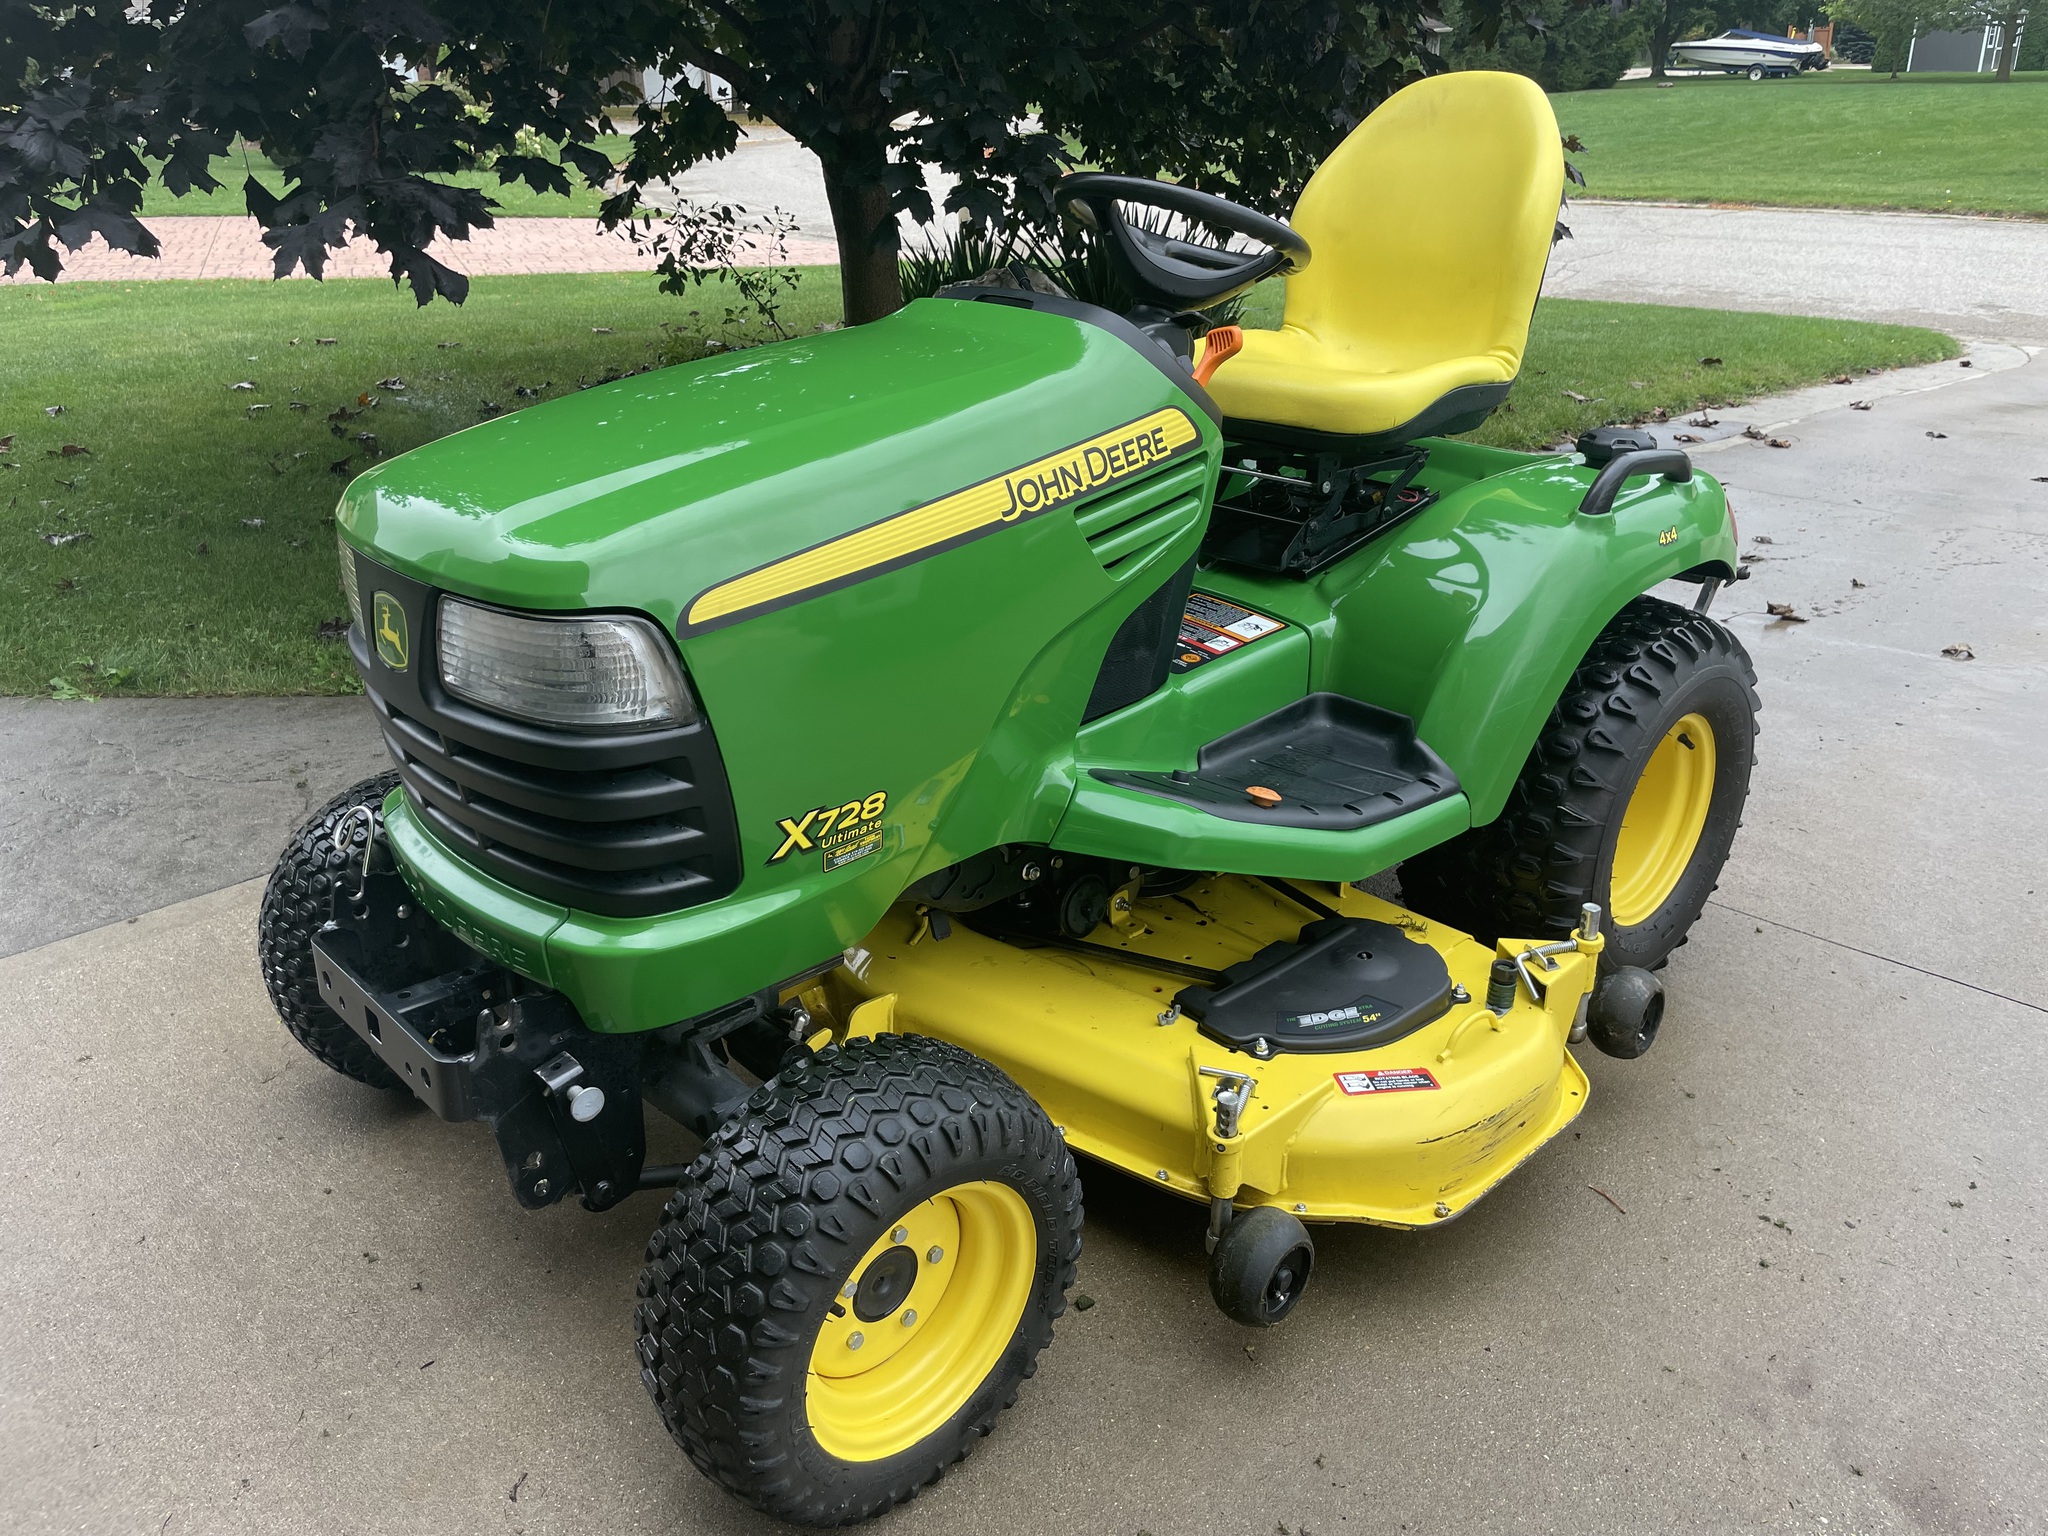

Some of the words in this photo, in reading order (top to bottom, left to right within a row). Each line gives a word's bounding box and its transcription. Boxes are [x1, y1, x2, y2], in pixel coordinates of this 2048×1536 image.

[1001, 461, 1083, 518] JOHN
[1083, 426, 1168, 482] DEERE
[1660, 526, 1677, 545] 4x4
[769, 790, 888, 861] X728
[821, 819, 882, 849] Ultimate
[1297, 1006, 1360, 1028] EDGE
[1315, 1021, 1339, 1030] CUTTING
[1339, 1018, 1362, 1027] SYSTEM
[1362, 1013, 1381, 1023] 54"
[1024, 1178, 1058, 1231] FIELD
